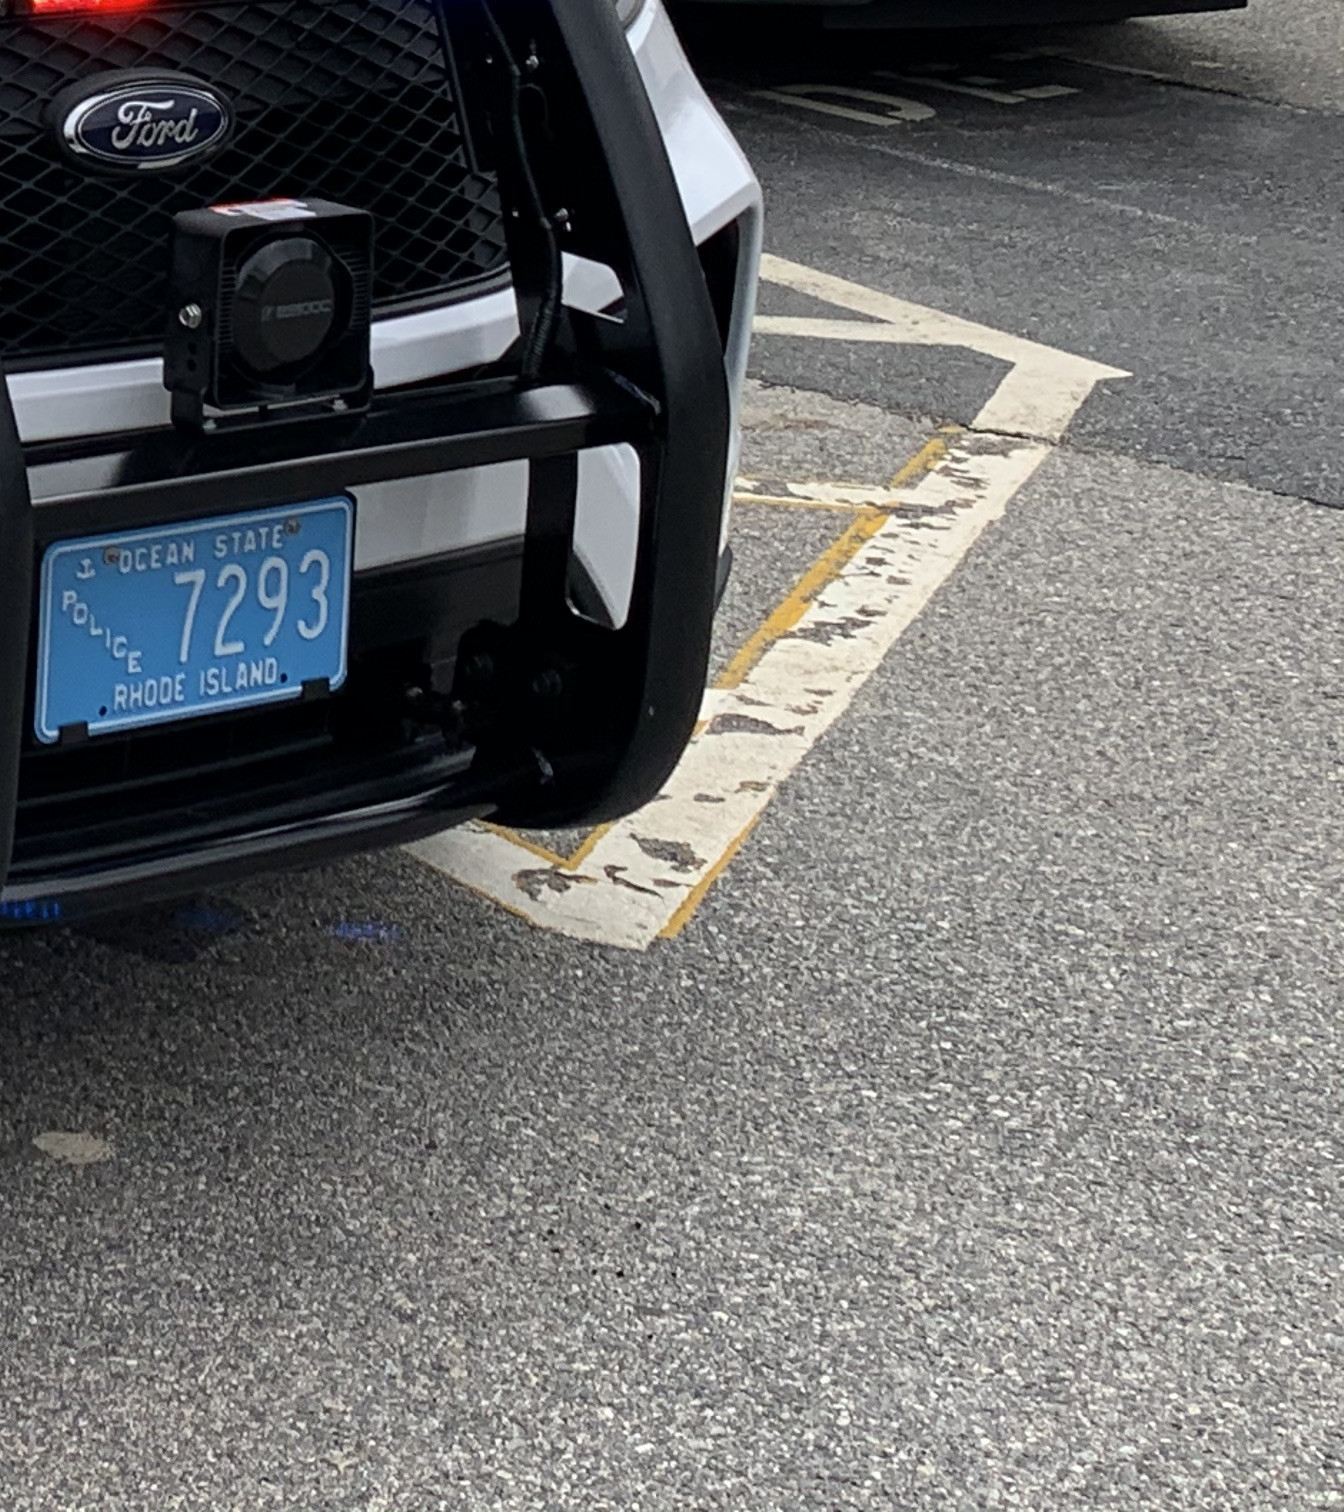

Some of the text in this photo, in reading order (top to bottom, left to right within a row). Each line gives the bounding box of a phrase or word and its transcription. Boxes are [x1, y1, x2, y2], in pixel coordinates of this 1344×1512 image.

[112, 100, 199, 150] Ford
[117, 523, 284, 574] OCEAN STATE
[62, 590, 143, 674] POLICE
[173, 549, 331, 664] 7293
[113, 656, 279, 711] RHODE ISLAND
